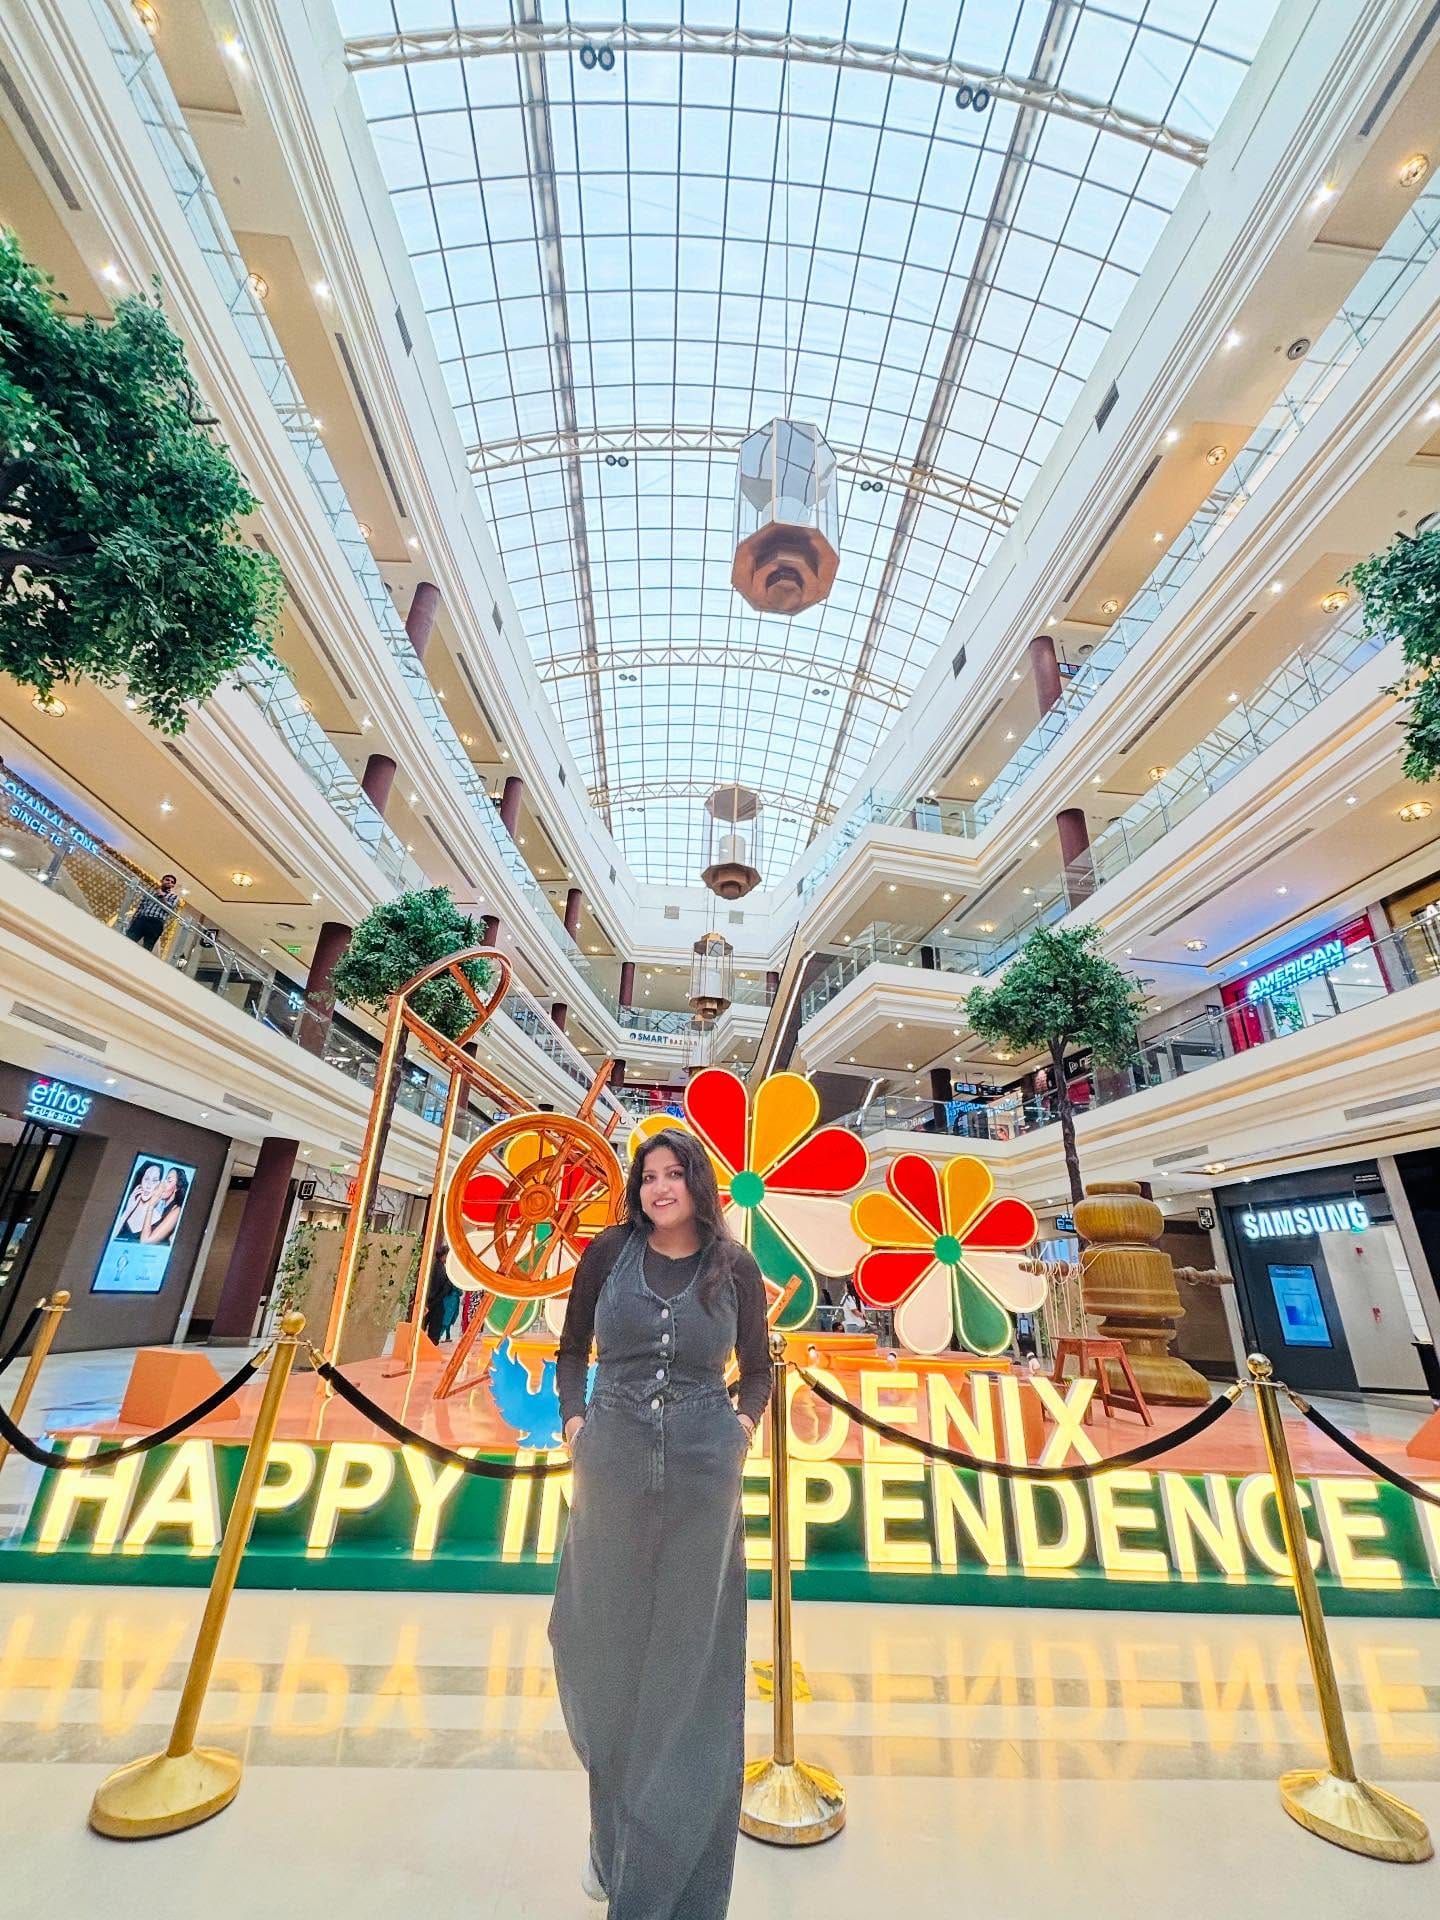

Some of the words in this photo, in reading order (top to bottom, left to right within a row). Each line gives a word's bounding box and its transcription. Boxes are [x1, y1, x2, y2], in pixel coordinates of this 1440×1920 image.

[10, 805, 48, 836] SINCE
[1247, 939, 1342, 997] AMERICAN
[638, 1032, 669, 1045] SMART
[1242, 1200, 1369, 1240] SAMSUNG
[37, 1436, 482, 1555] HAPPY
